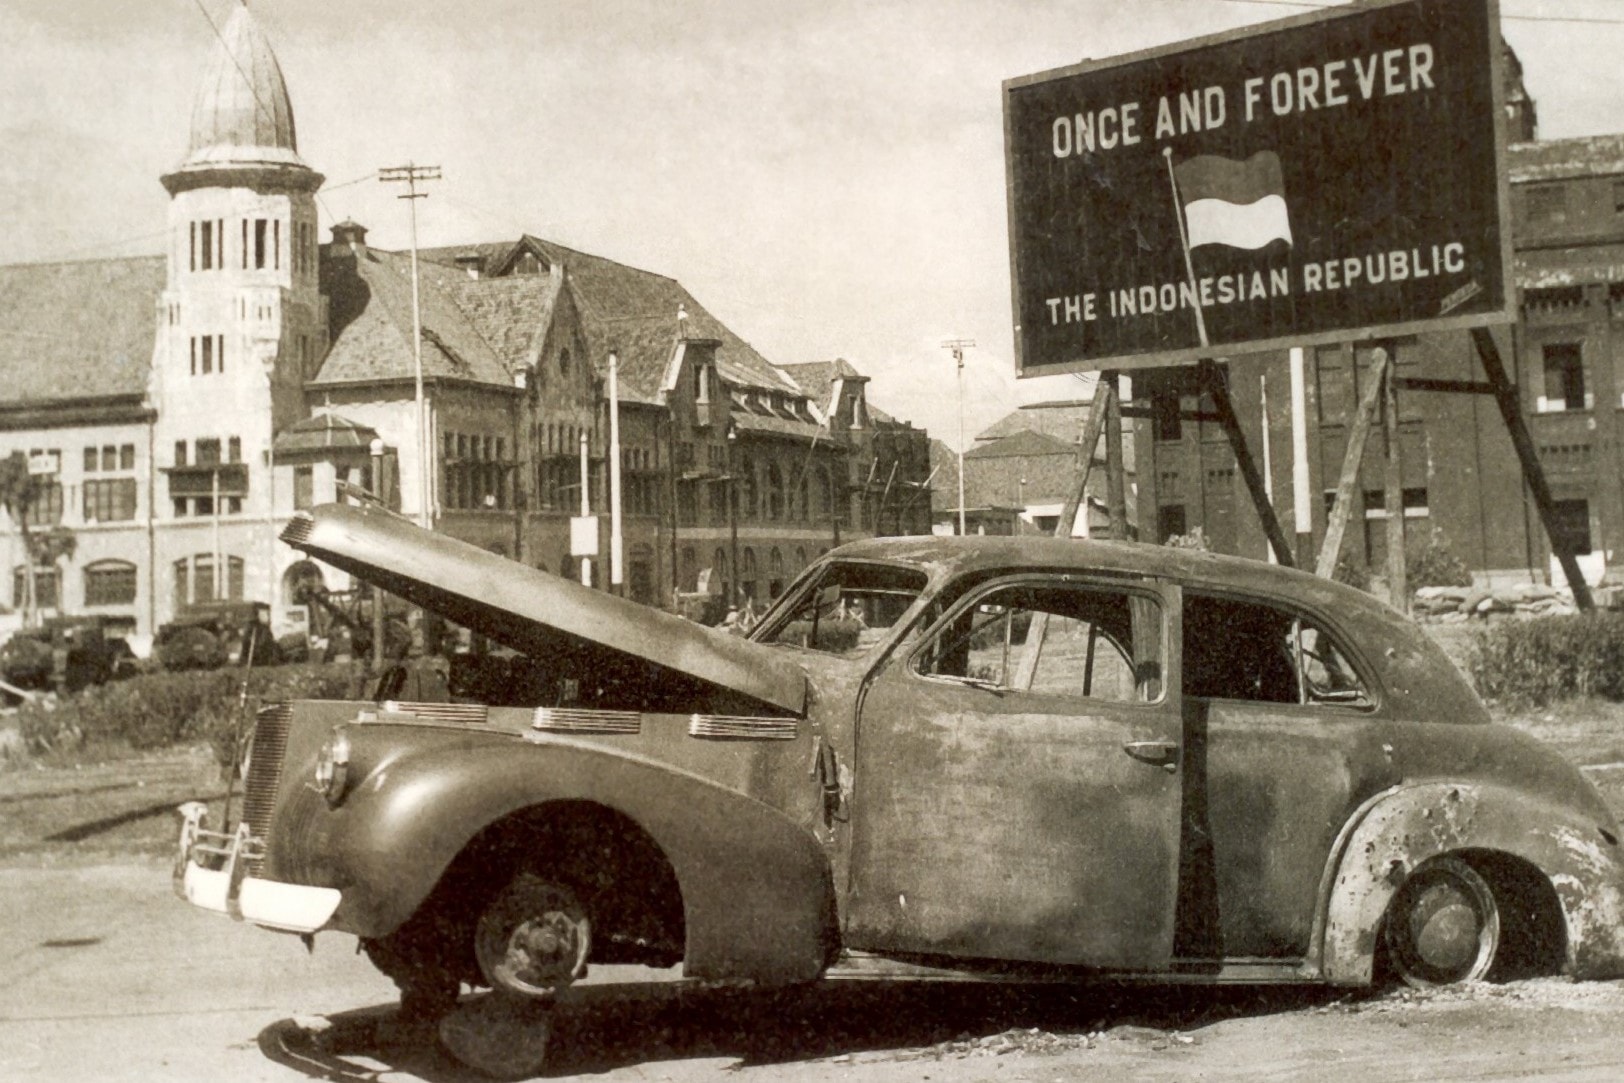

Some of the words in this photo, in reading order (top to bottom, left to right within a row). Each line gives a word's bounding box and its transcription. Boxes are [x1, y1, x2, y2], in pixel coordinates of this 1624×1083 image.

[1052, 102, 1141, 158] ONCE
[1155, 85, 1226, 140] AND
[1244, 43, 1435, 122] FOREVER
[1046, 292, 1097, 326] THE
[1110, 267, 1290, 318] INDONESIAN
[1304, 242, 1465, 292] REPUBLIC
